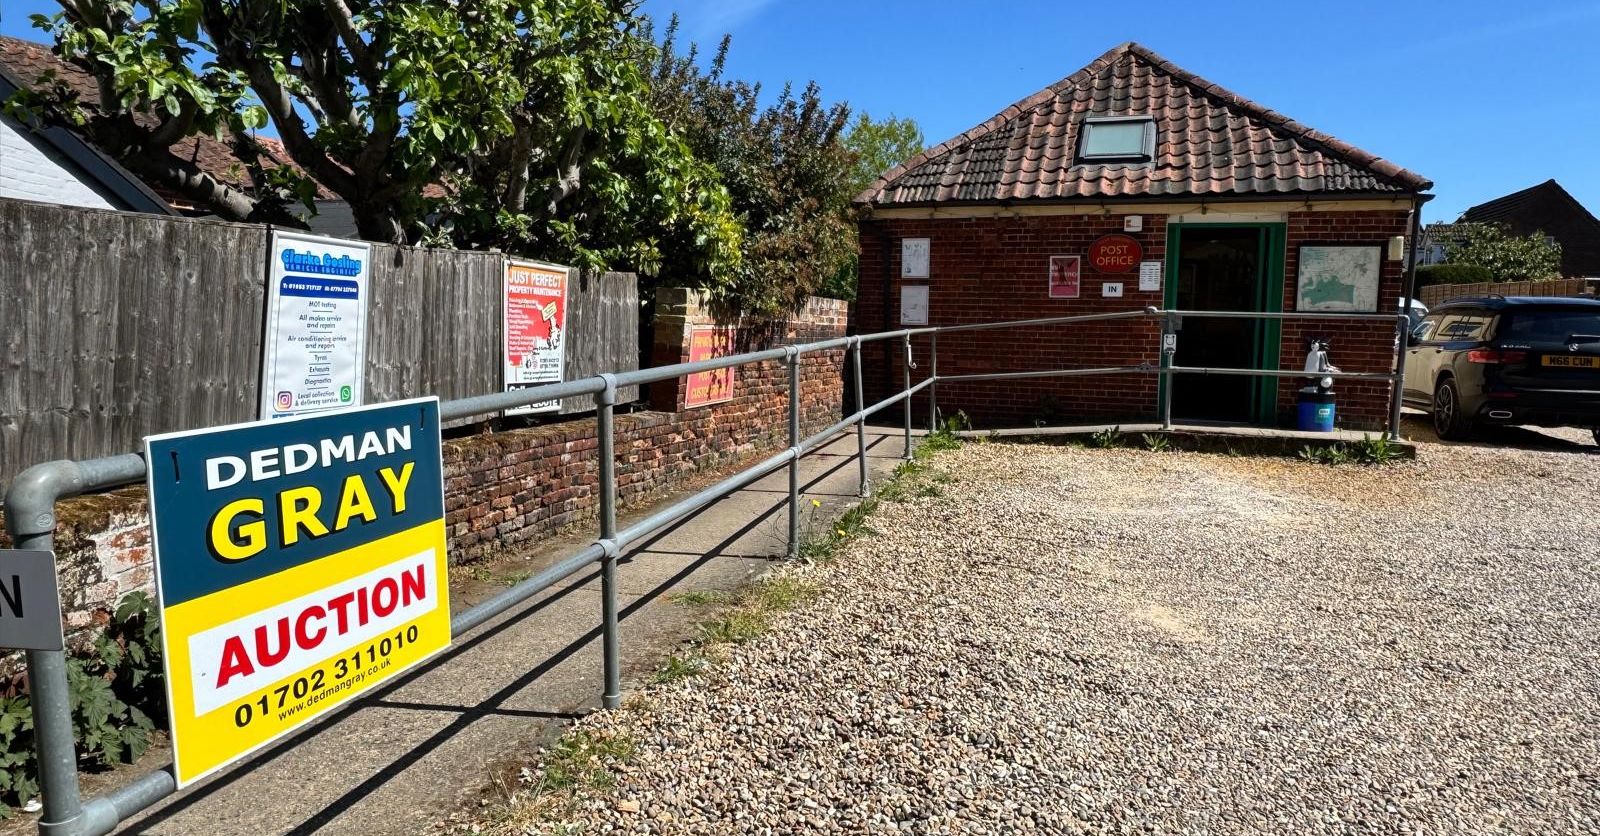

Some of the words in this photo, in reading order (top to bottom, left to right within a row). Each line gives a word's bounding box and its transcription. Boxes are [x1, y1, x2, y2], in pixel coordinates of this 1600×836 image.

[281, 249, 321, 266] Clarke
[323, 253, 361, 274] Gosling
[1096, 256, 1134, 266] OFFICE
[1100, 245, 1128, 255] POST
[509, 270, 529, 284] JUST
[530, 271, 562, 288] PERFECT
[509, 285, 533, 295] PROPERTY
[206, 425, 412, 490] DEDMAN
[208, 462, 415, 564] GRAY
[216, 564, 426, 689] AUCTION
[234, 669, 325, 728] 01702
[334, 625, 418, 680] 311010
[278, 658, 391, 721] www.dedmangray.co.uk
